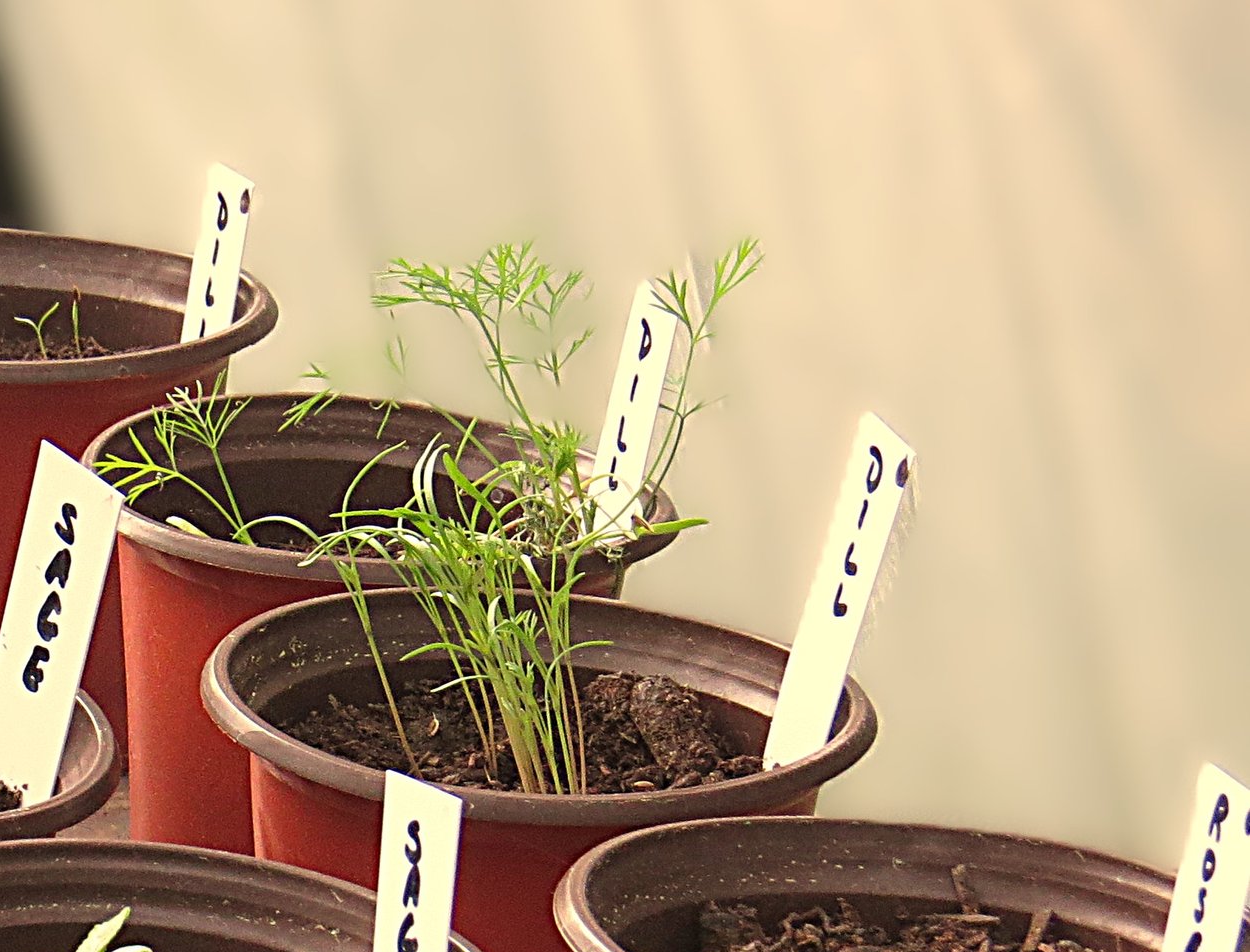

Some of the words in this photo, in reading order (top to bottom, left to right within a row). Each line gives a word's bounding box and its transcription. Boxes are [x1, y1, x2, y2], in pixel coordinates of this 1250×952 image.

[608, 317, 652, 491] DILL
[22, 502, 87, 692] SAGE
[833, 445, 883, 617] DILL
